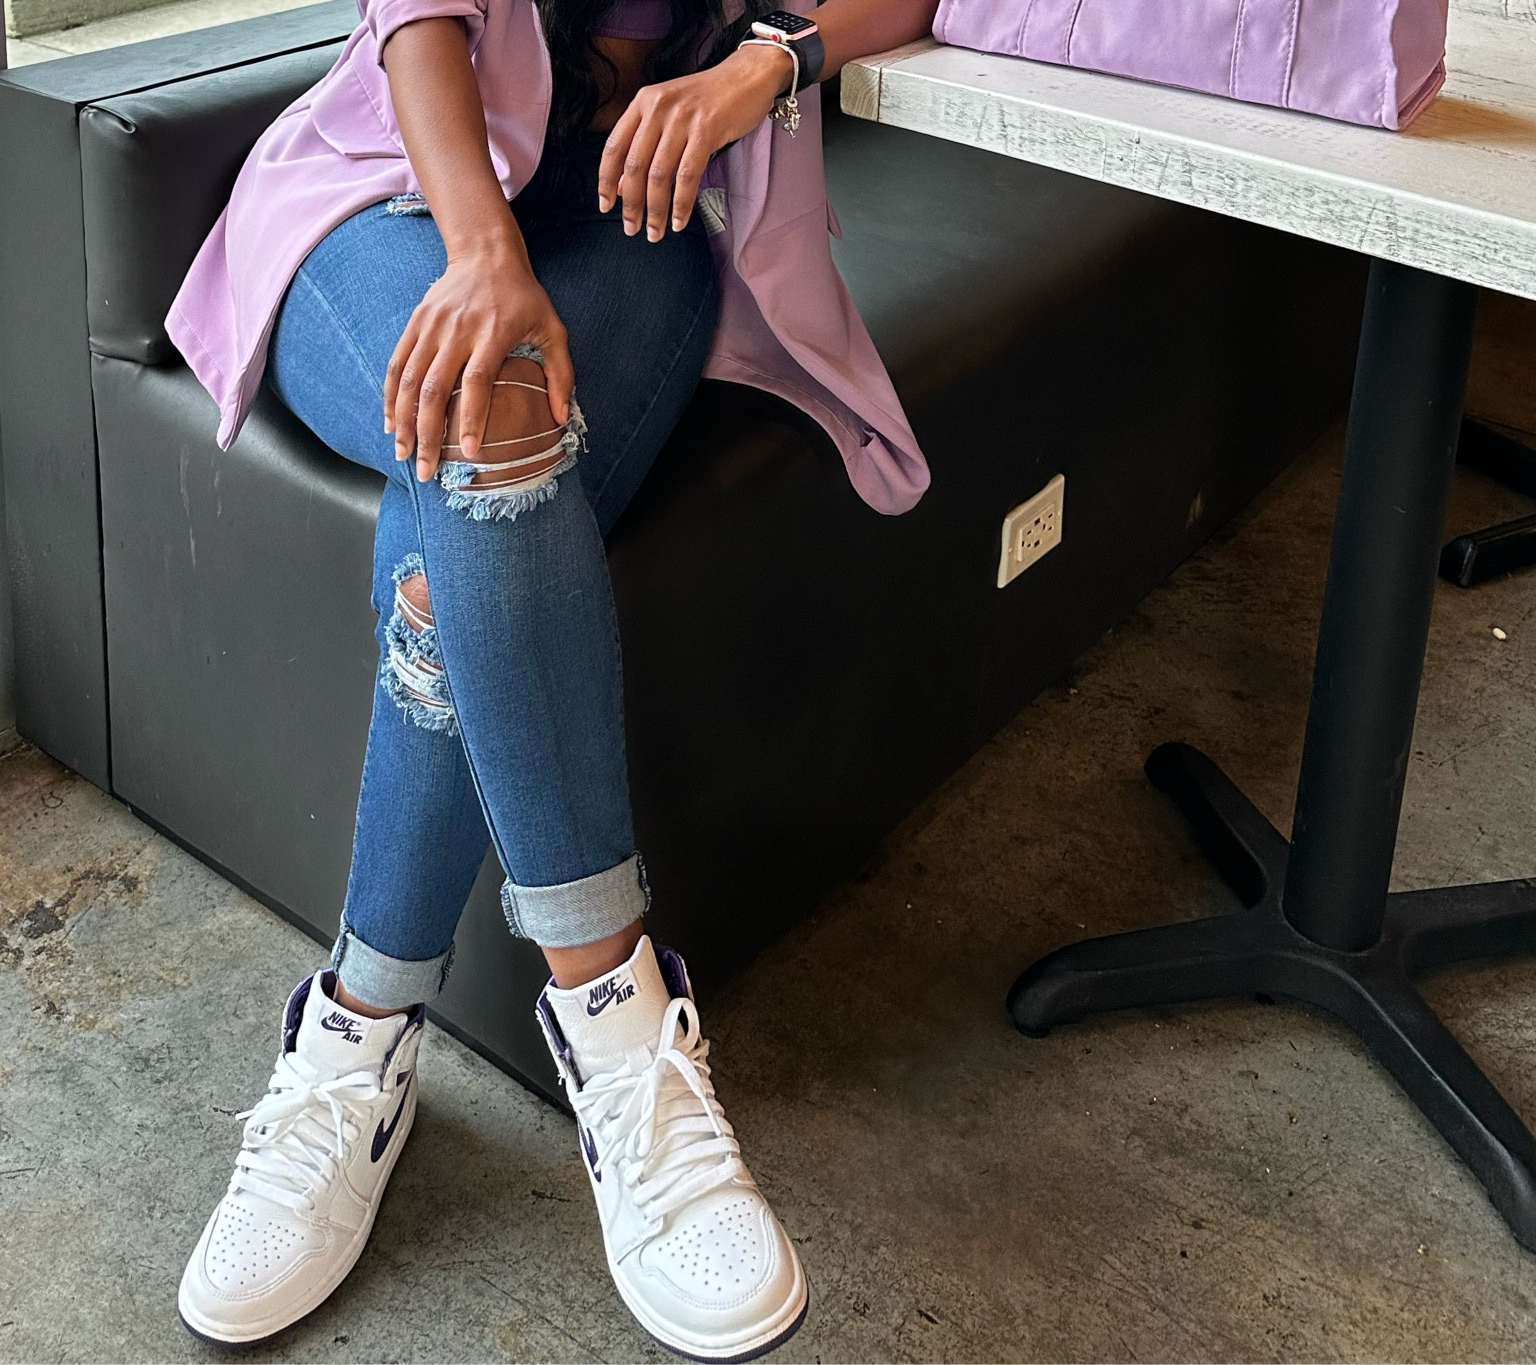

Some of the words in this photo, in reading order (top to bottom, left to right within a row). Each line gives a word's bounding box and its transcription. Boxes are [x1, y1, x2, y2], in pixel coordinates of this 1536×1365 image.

[588, 976, 617, 1005] NIKE
[616, 984, 636, 1006] AIR
[328, 1010, 357, 1032] NIKE
[341, 1031, 363, 1045] AIR
